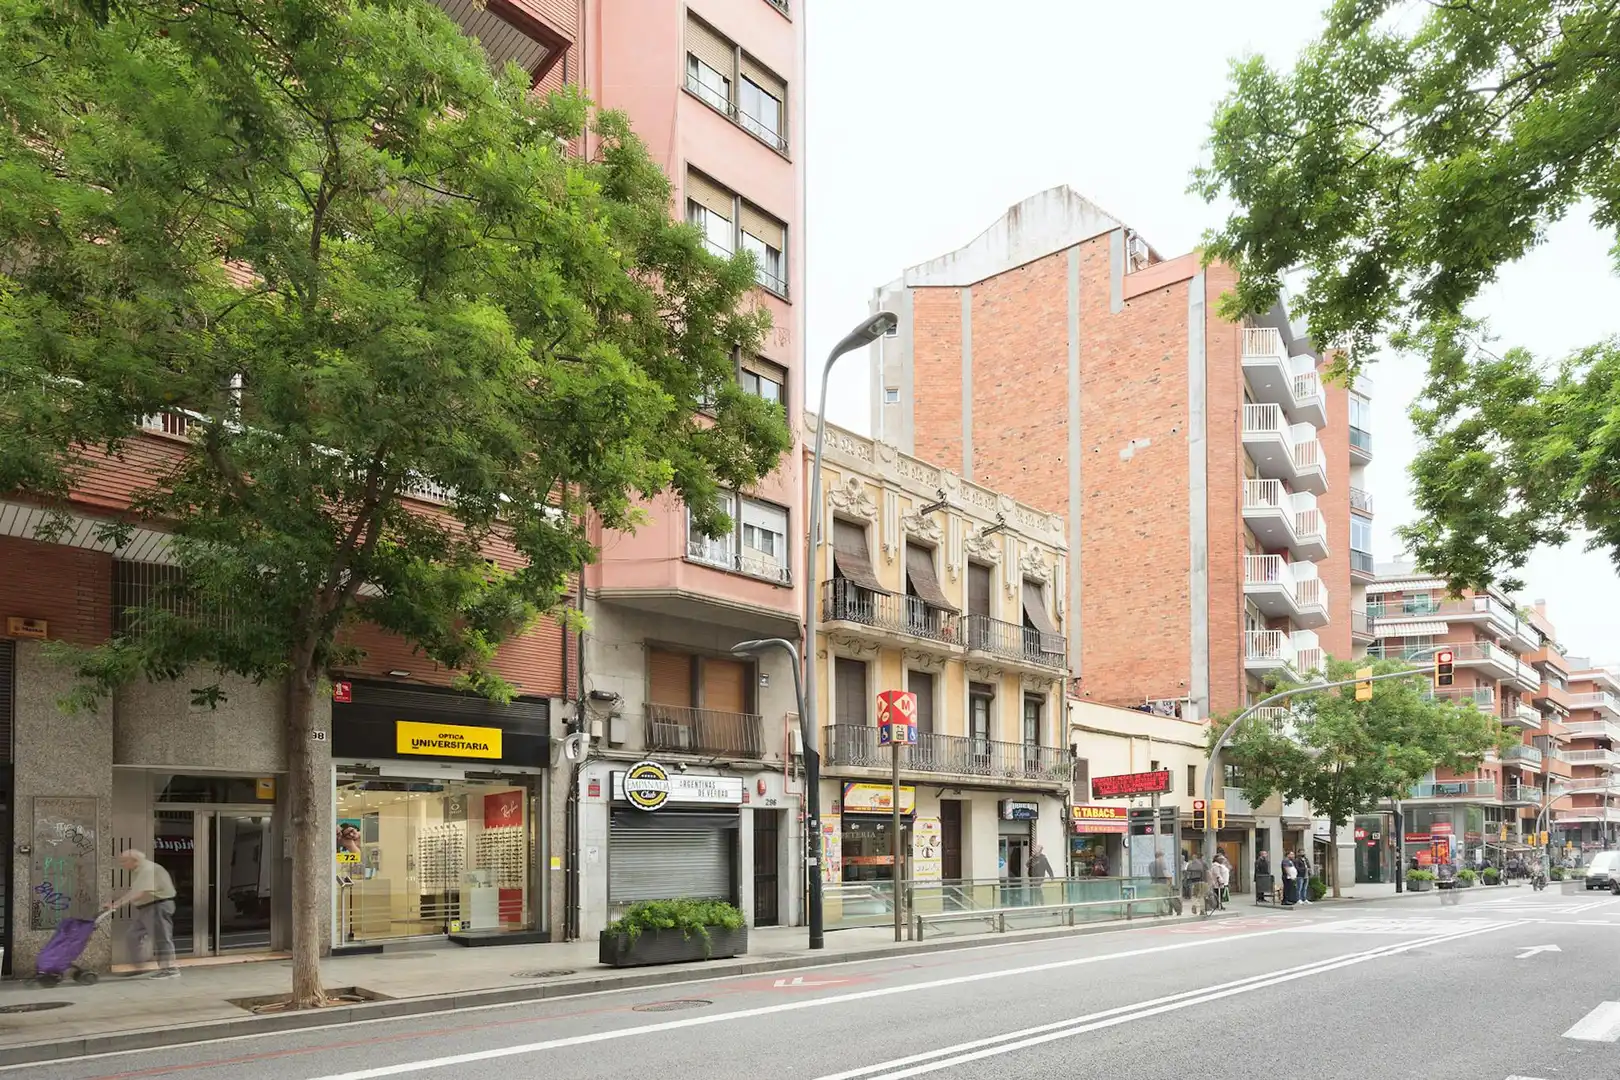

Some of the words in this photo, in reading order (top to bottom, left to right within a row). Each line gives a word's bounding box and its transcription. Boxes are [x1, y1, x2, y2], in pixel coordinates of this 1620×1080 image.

[901, 699, 910, 710] M
[412, 738, 489, 751] UNIVERSITARIA
[1081, 807, 1116, 818] TABACS
[1355, 830, 1365, 838] M
